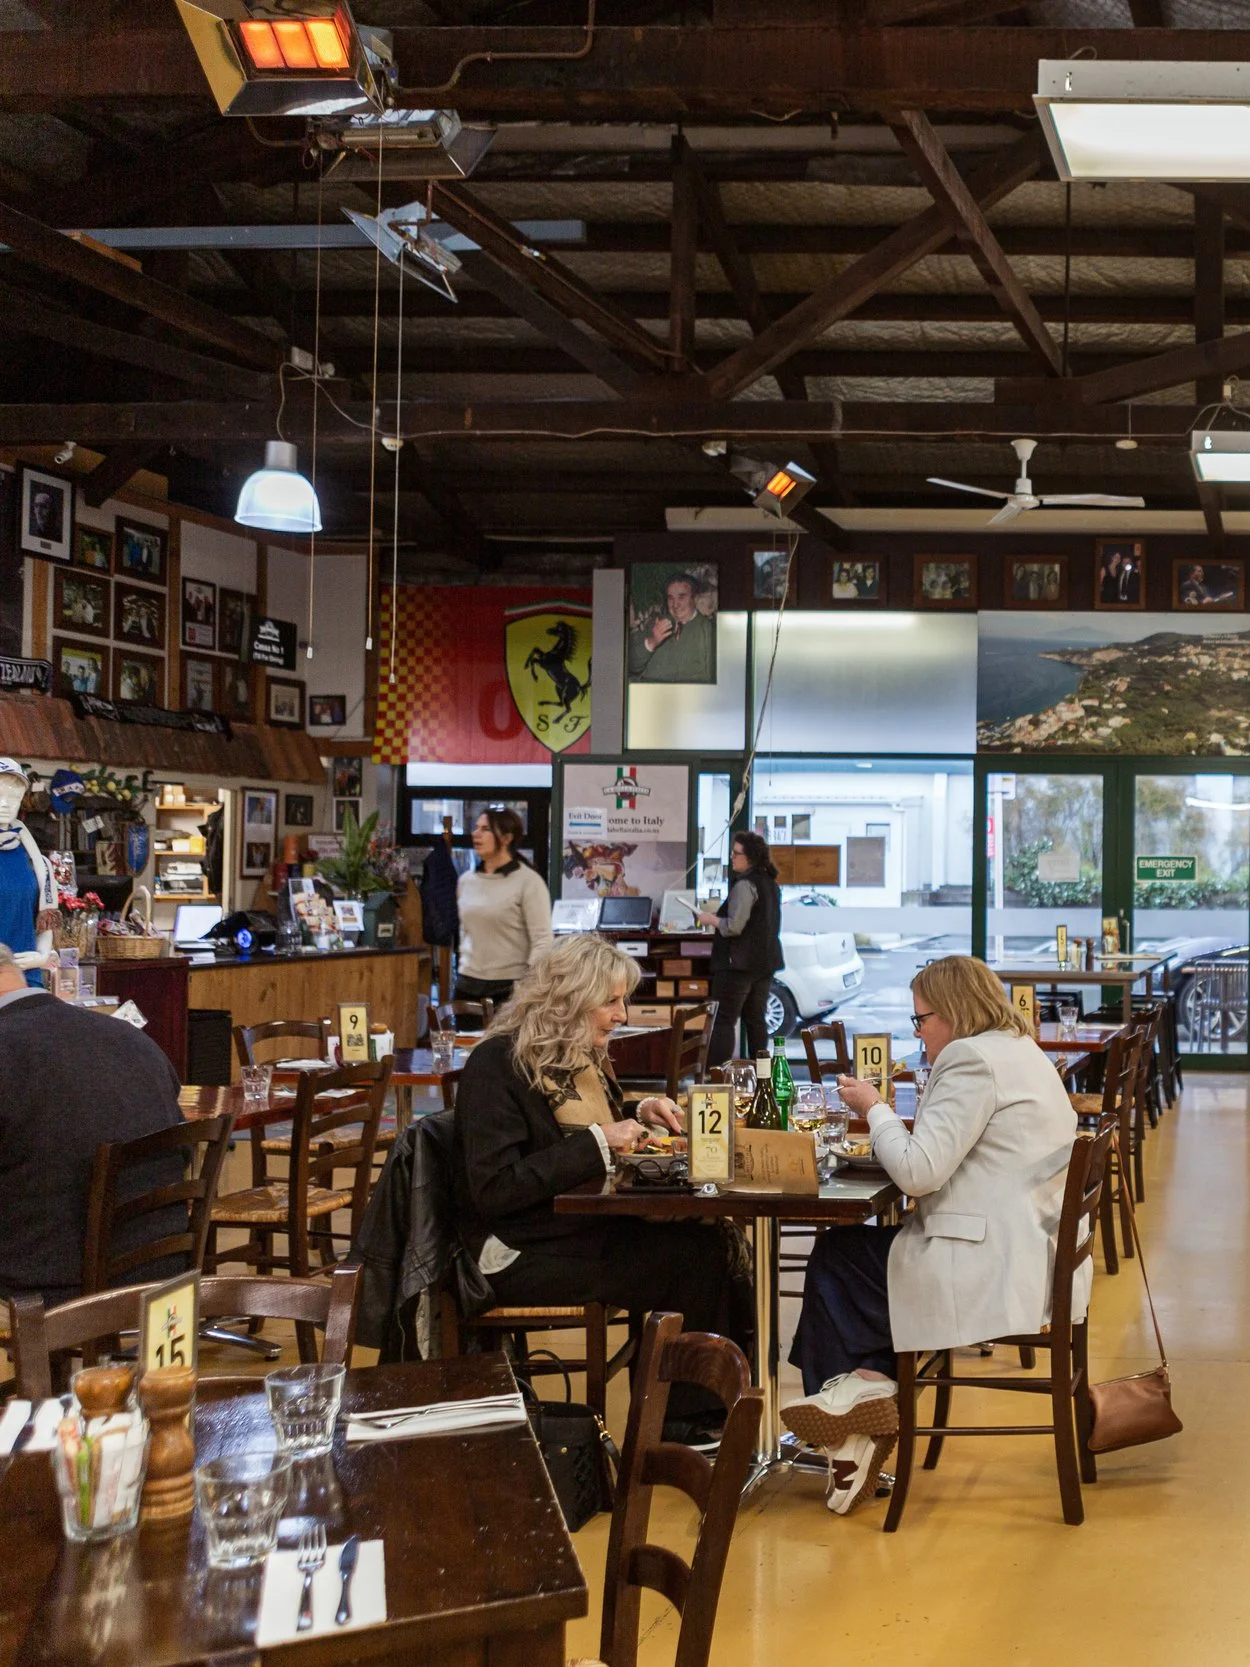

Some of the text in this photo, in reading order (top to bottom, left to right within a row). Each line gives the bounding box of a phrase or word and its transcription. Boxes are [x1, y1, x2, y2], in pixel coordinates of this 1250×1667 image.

[536, 714, 550, 732] S
[631, 817, 641, 825] to
[643, 816, 664, 827] Italy
[1139, 859, 1194, 870] EMERGENCY
[1156, 869, 1176, 878] EXIT
[1018, 994, 1027, 1007] 6
[350, 1014, 359, 1030] 9
[861, 1046, 882, 1066] 10
[697, 1109, 722, 1135] 12
[156, 1333, 185, 1368] 15
